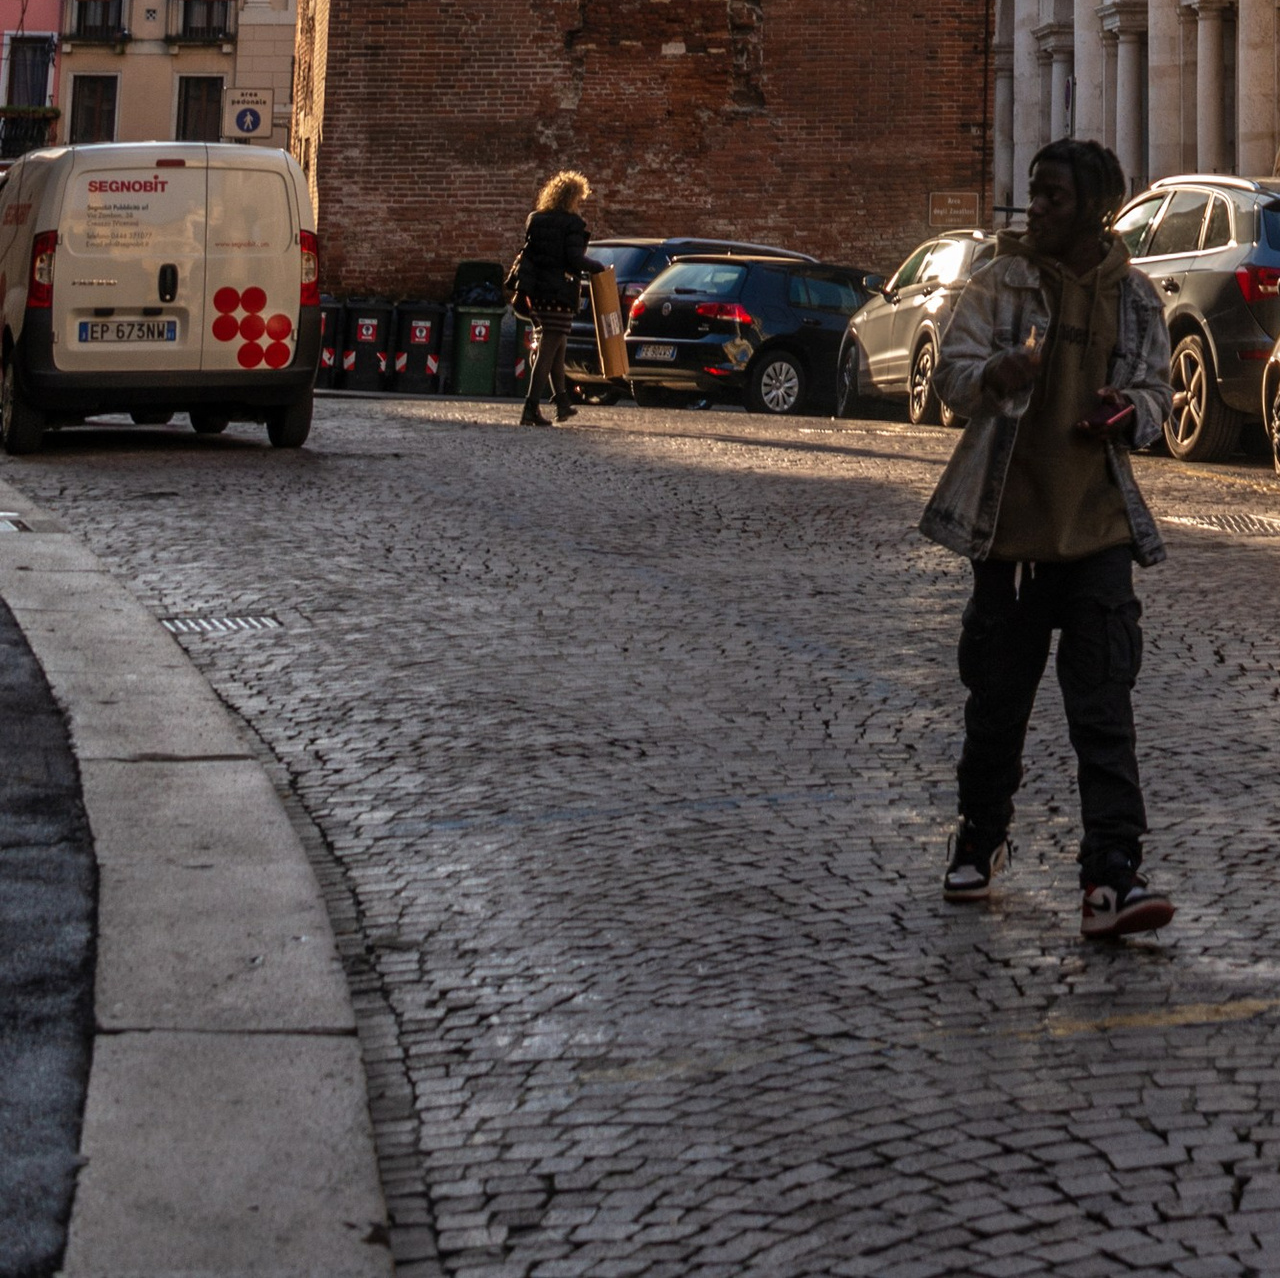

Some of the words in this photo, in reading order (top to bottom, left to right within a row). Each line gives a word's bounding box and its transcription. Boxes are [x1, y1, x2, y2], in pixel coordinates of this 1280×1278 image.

[231, 98, 267, 106] pedonale
[90, 324, 110, 340] EP
[116, 324, 166, 340] 673NW
